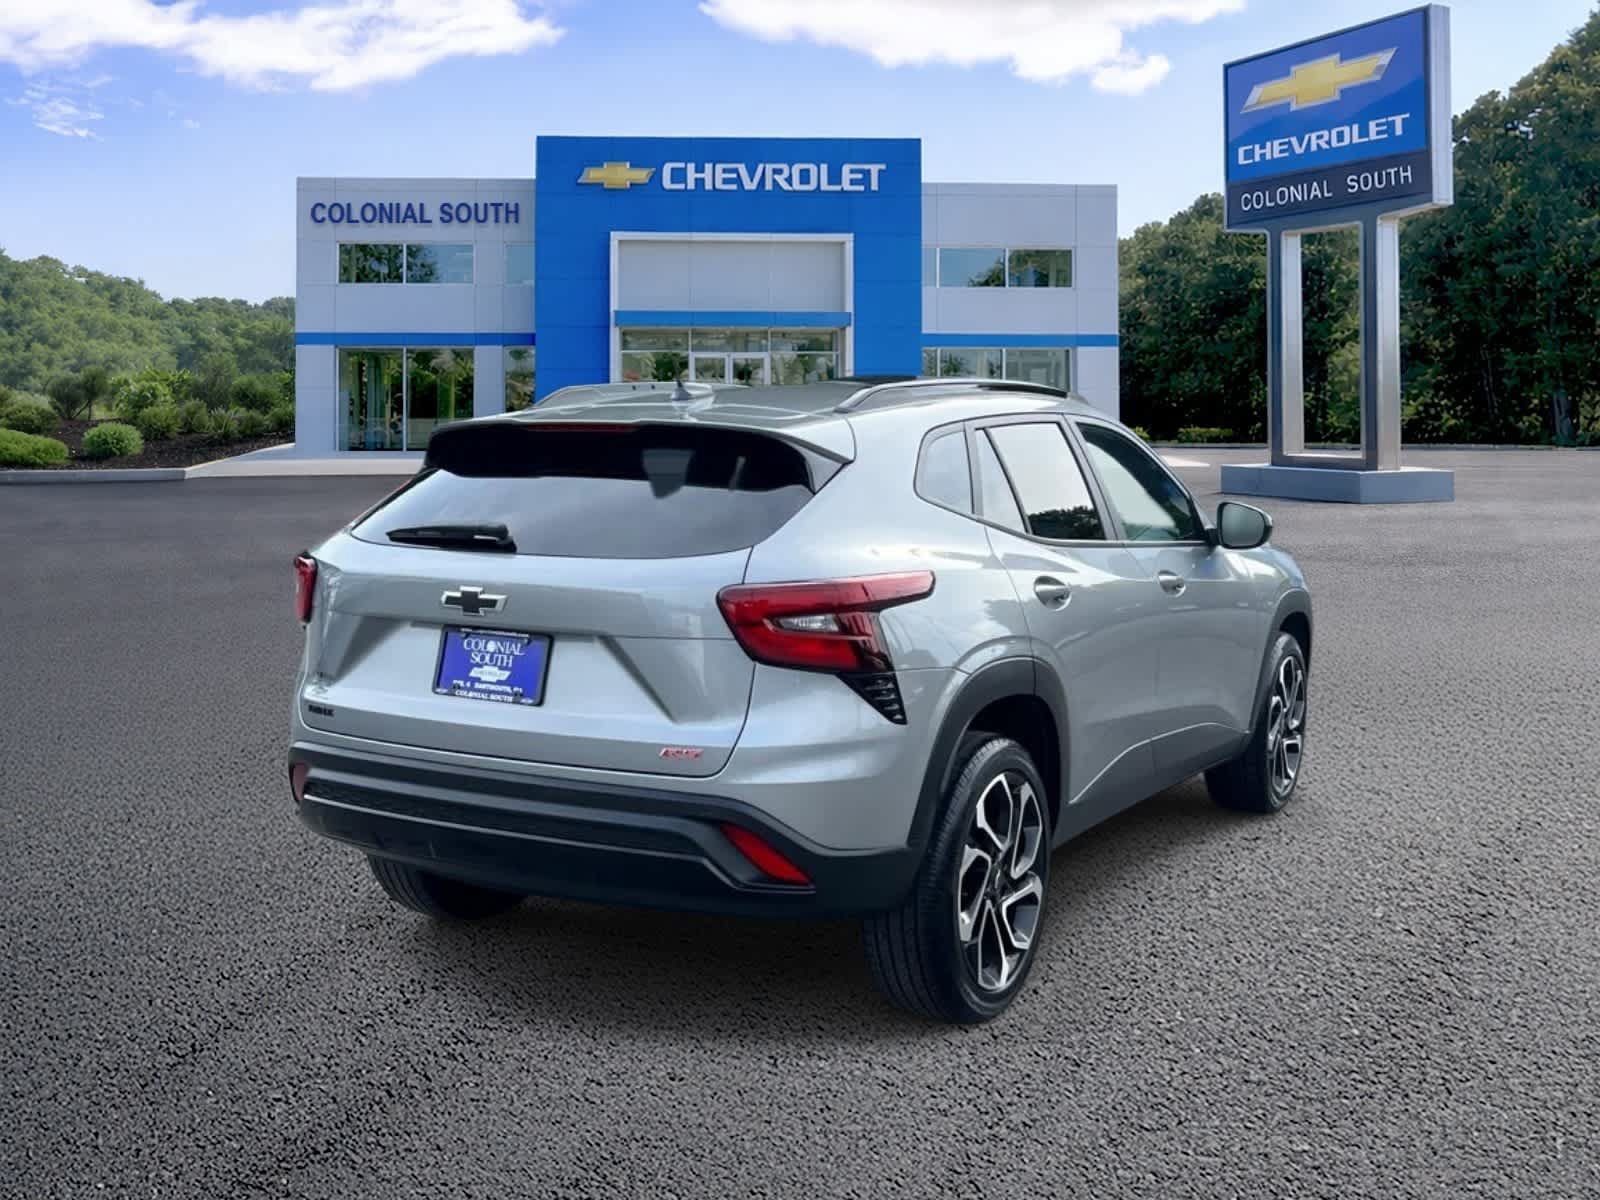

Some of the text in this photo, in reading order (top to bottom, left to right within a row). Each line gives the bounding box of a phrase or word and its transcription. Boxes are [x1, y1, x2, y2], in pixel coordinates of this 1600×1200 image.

[1237, 112, 1410, 165] CHEVROLET
[661, 161, 887, 192] CHEVROLET
[1240, 165, 1413, 211] COLONIAL SOUTH
[310, 202, 520, 224] COLONIAL SOUTH
[463, 638, 525, 656] COLONIAL
[470, 652, 514, 668] SOUTH
